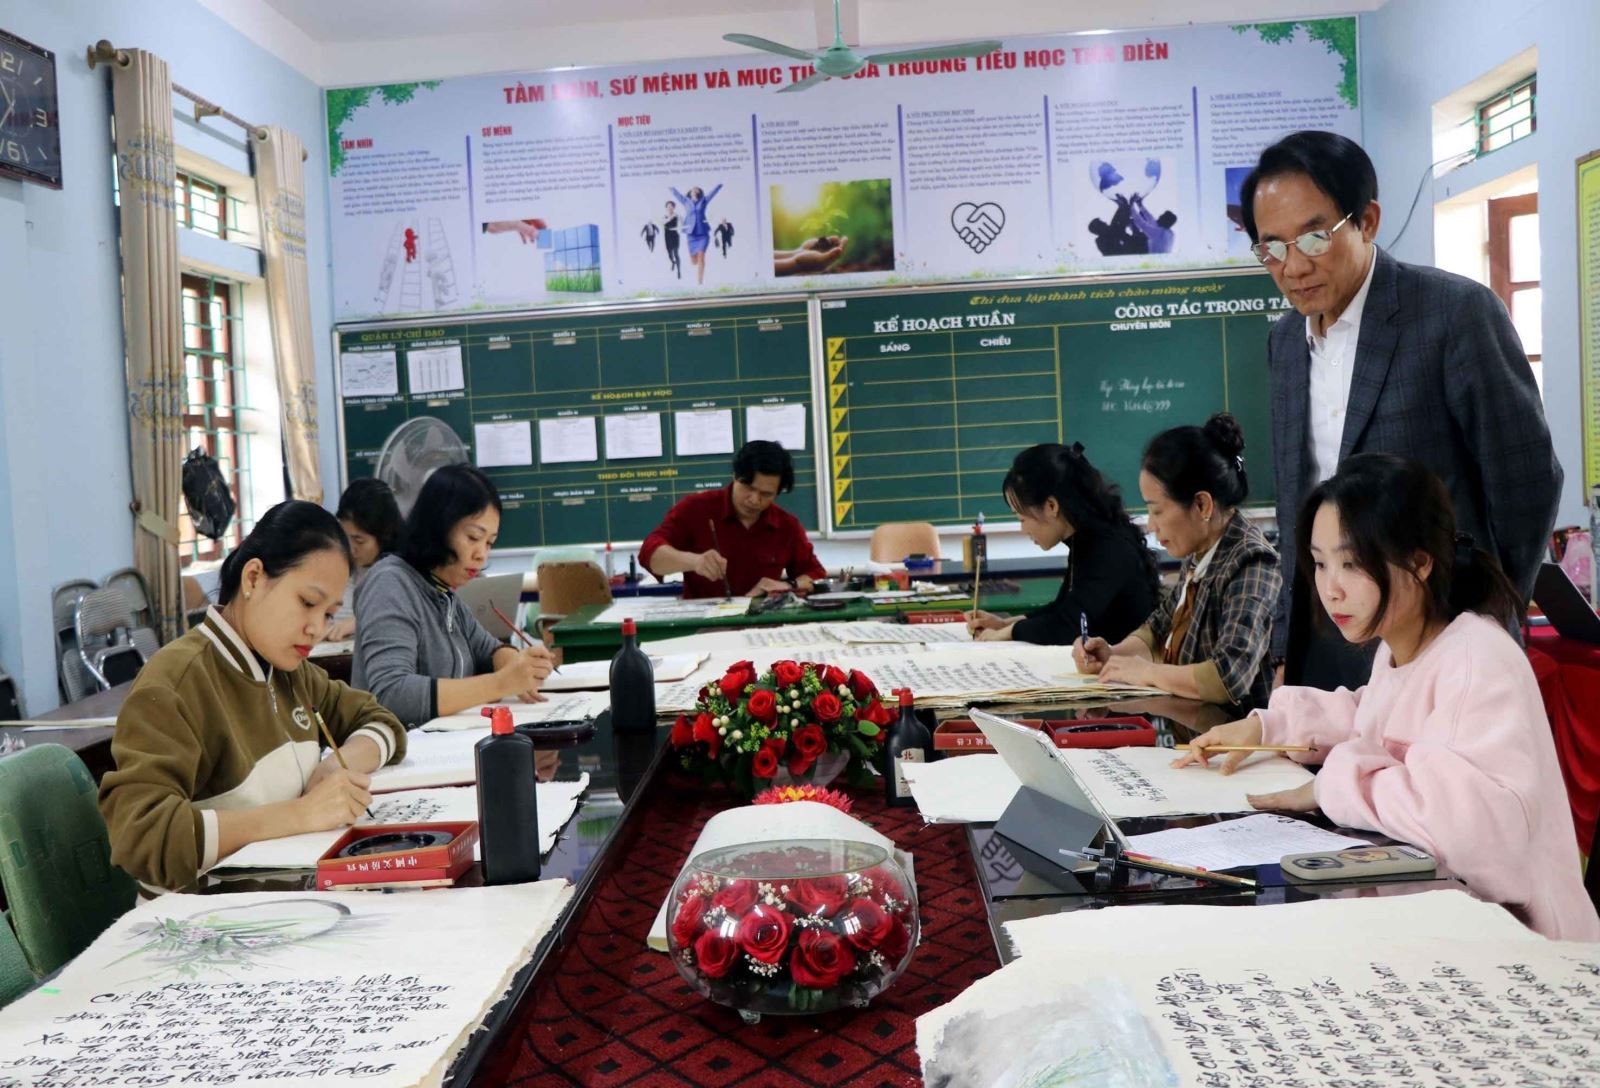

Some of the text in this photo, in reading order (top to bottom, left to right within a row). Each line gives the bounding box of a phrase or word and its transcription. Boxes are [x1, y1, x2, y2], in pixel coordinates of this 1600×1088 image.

[503, 80, 545, 104] TẦM
[610, 75, 637, 97] SỨ
[643, 72, 697, 95] MỆNH
[704, 69, 731, 89] VÀ
[737, 66, 782, 88] MỤC
[1024, 48, 1065, 70] HỌC
[1123, 38, 1168, 62] ĐIỀN
[36, 108, 48, 127] 3
[7, 141, 20, 161] 6
[1115, 302, 1164, 319] CÔNG
[1167, 299, 1201, 316] TÁC
[1204, 298, 1265, 315] TRỌNG
[873, 309, 1015, 333] KẾ HOẠCH TUẦN
[880, 341, 911, 352] SÁNG
[980, 335, 1011, 347] CHIỀU
